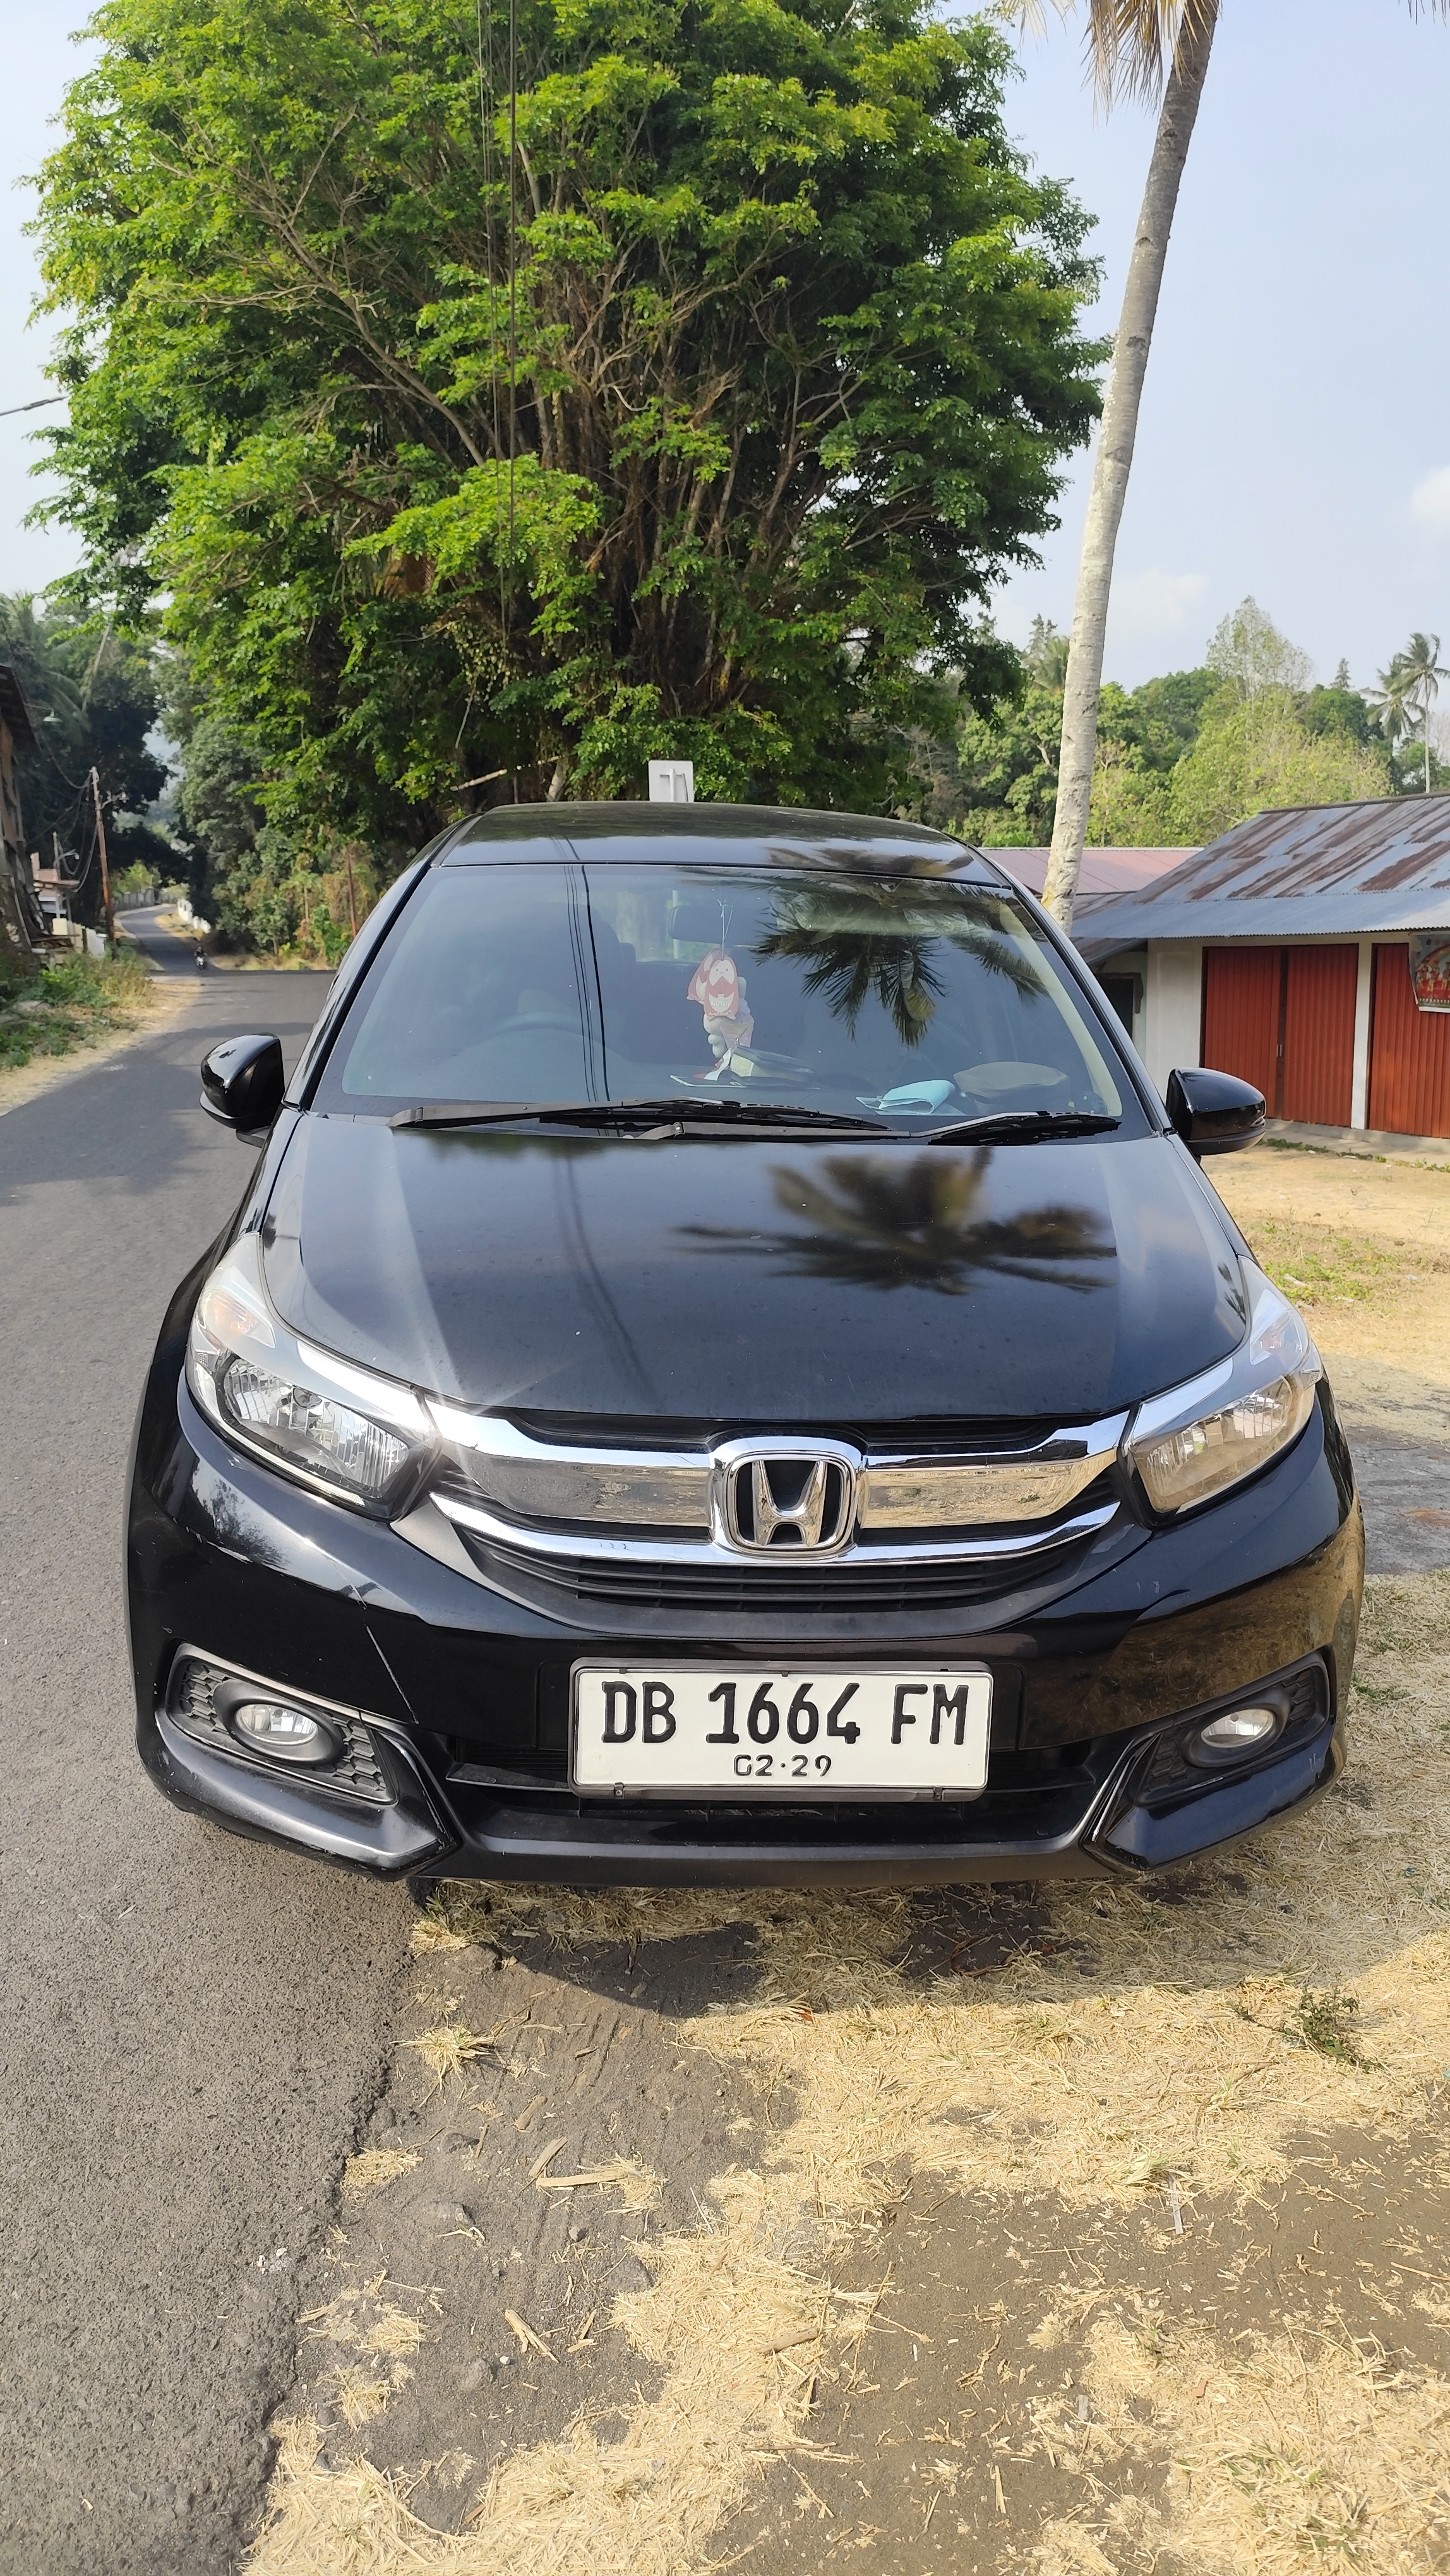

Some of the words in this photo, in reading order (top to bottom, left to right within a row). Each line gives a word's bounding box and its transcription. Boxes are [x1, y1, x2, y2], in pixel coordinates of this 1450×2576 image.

[601, 1681, 676, 1744] DB
[705, 1681, 861, 1744] 1664
[890, 1683, 969, 1746] FM
